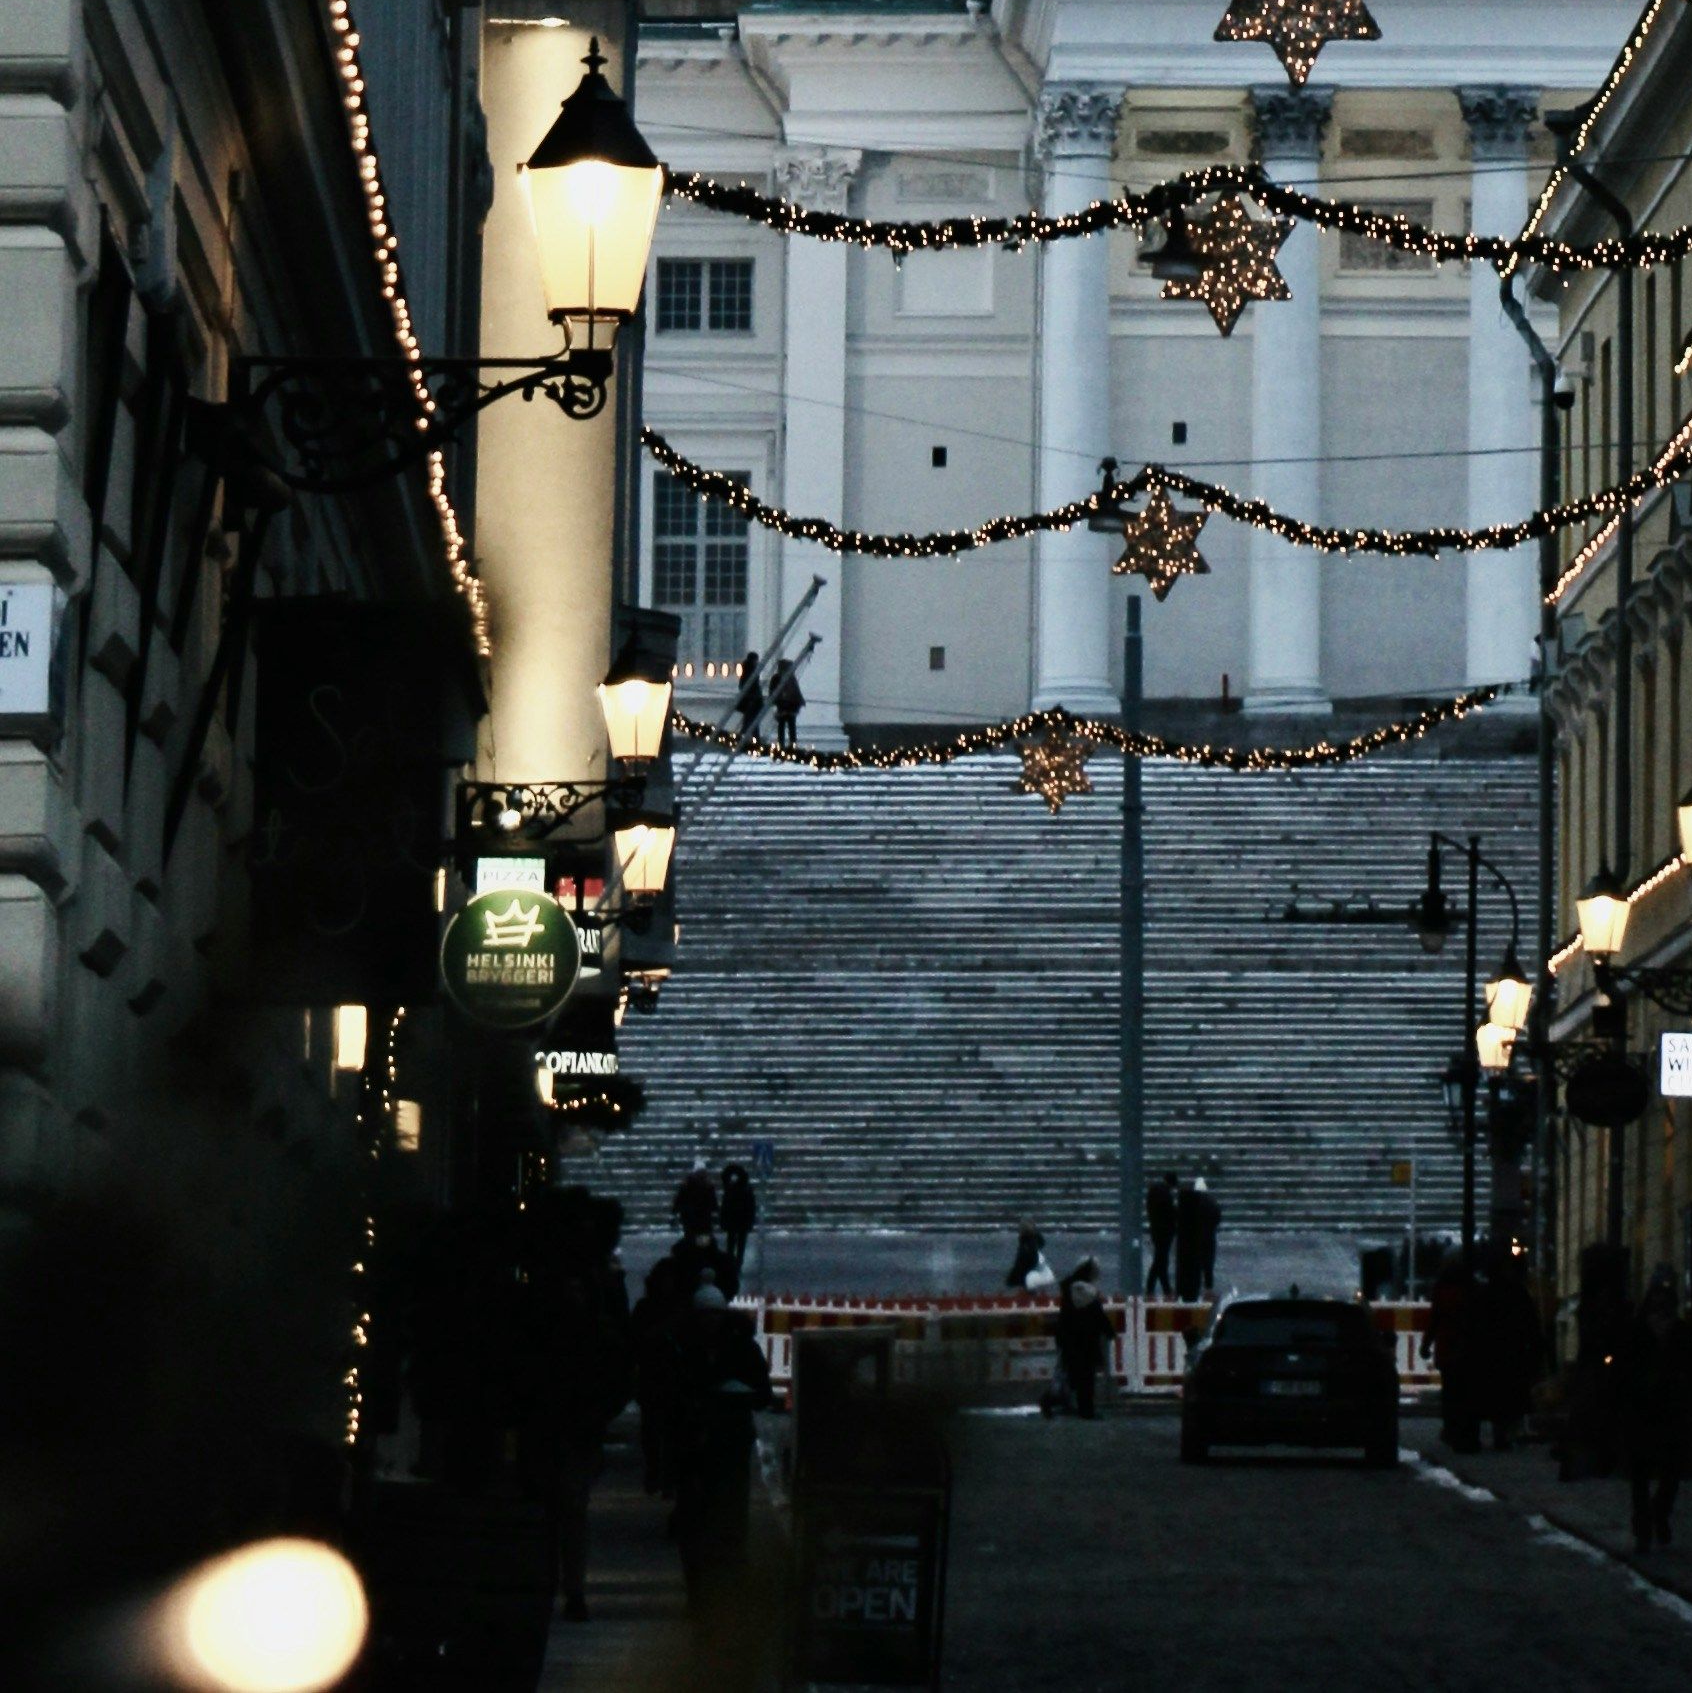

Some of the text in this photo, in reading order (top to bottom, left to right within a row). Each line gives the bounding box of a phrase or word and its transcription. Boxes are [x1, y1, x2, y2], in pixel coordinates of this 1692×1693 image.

[482, 870, 539, 881] PIZZA
[466, 953, 555, 968] HELSINKI
[466, 968, 555, 984] BRYGGERI
[811, 1585, 918, 1621] OPEN
